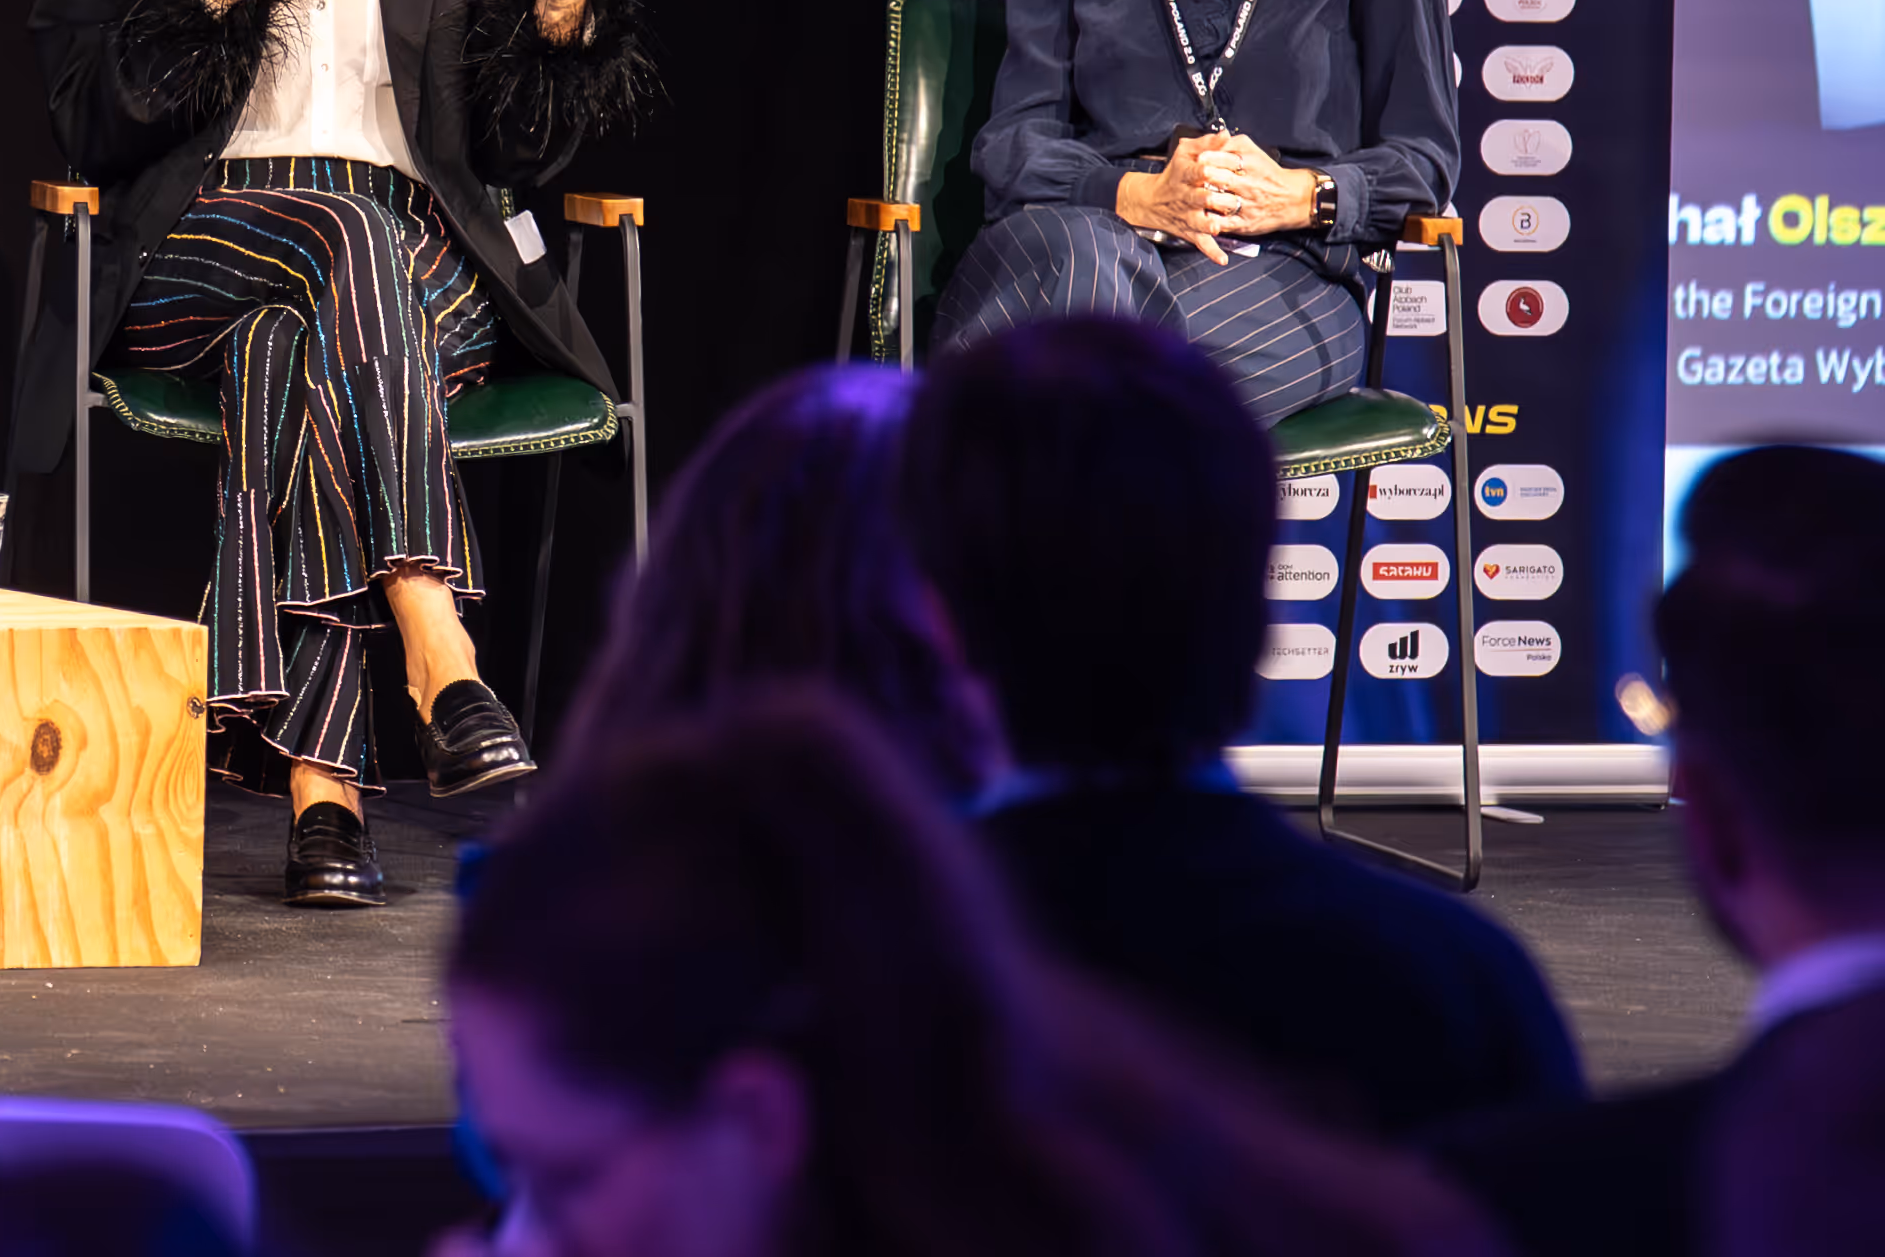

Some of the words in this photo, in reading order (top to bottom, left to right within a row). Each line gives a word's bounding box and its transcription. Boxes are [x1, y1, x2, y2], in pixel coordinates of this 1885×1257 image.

[1230, 1, 1252, 49] POLAND
[1169, 2, 1190, 46] POLAND
[1192, 72, 1207, 96] BCG
[1668, 193, 1762, 246] hał
[1768, 193, 1885, 246] Olsz
[1673, 280, 1734, 320] the
[1743, 281, 1883, 328] Foreign
[1677, 346, 1805, 386] Gazeta
[1278, 483, 1330, 501] yborcza
[1378, 483, 1445, 500] wyborcza.pl
[1484, 485, 1505, 498] tvn
[1277, 570, 1331, 581] attention
[1505, 565, 1556, 574] SARIGATO
[1482, 635, 1516, 647] Force
[1517, 635, 1552, 647] News
[1388, 664, 1419, 676] zryw
